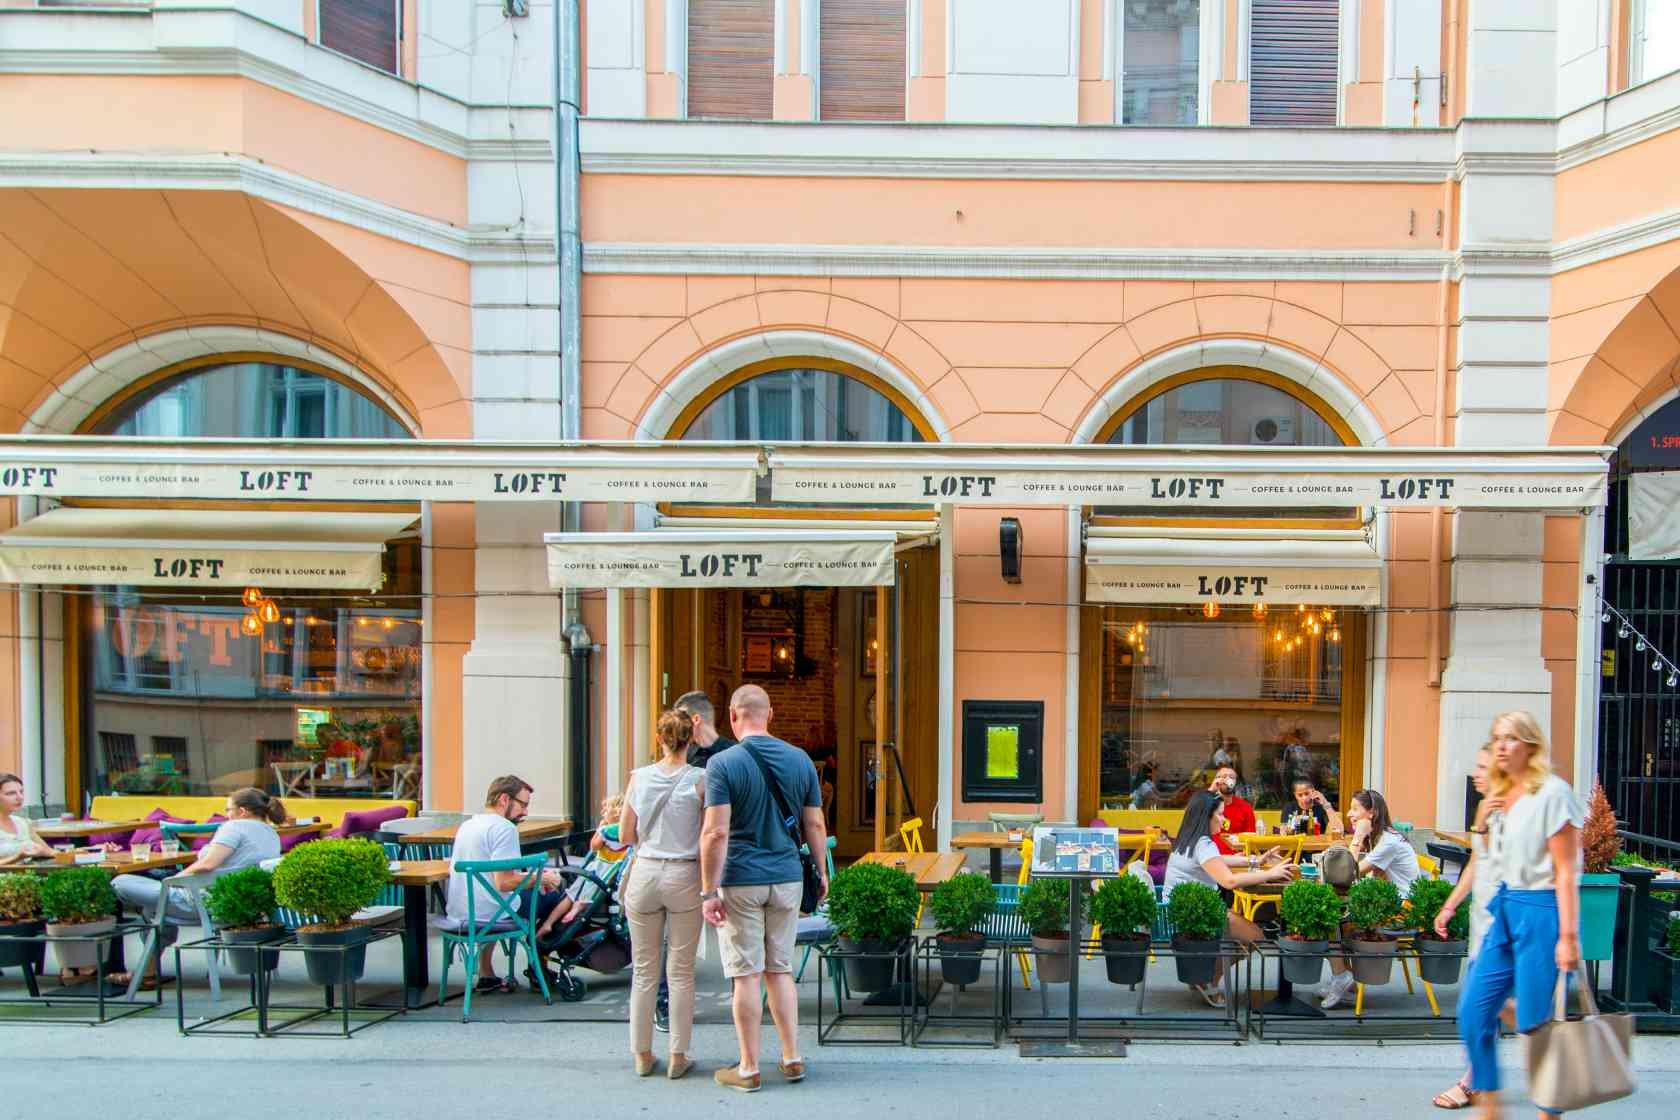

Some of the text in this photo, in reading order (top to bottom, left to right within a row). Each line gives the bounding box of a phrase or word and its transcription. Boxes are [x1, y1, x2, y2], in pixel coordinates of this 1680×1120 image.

[98, 475, 132, 483] COFFEE
[144, 475, 178, 483] LOUNGE
[181, 476, 200, 484] BAR
[240, 471, 312, 491] LOFT
[352, 478, 385, 486] COFFEE
[397, 479, 432, 487] LOUNGE
[436, 479, 454, 487] BAR
[494, 473, 566, 493] LOFT
[607, 481, 640, 489] COFFEE
[652, 481, 686, 489] LOUNGE
[690, 481, 708, 489] BAR
[795, 481, 828, 489] COFFEE
[840, 482, 875, 490] LOUNGE
[878, 482, 897, 490] BAR
[923, 476, 995, 496] LOFT
[1023, 484, 1056, 492] COFFEE
[1068, 485, 1102, 493] LOUNGE
[1106, 485, 1125, 493] BAR
[1151, 478, 1224, 498] LOFT
[1380, 479, 1454, 499] LOFT
[1251, 486, 1285, 494] COFFEE
[1297, 486, 1332, 494] LOUNGE
[1336, 486, 1354, 494] BAR
[1481, 486, 1515, 494] COFFEE
[1527, 486, 1562, 494] LOUNGE
[1566, 486, 1584, 494] BAR
[32, 564, 62, 572] COFFEE
[74, 564, 106, 572] LOUNGE
[110, 565, 128, 573] BAR
[154, 558, 223, 578] LOFT
[564, 562, 596, 570] COFFEE
[607, 562, 640, 570] LOUNGE
[642, 562, 660, 570] BAR
[680, 554, 762, 577] LOFT
[783, 562, 815, 570] COFFEE
[825, 561, 859, 569] LOUNGE
[861, 561, 878, 569] BAR
[249, 567, 281, 575] COFFEE
[292, 568, 327, 576] LOUNGE
[329, 568, 347, 576] BAR
[1102, 581, 1128, 589] COFFEE
[1136, 582, 1165, 590] LOUNGE
[1166, 582, 1181, 590] BAR
[1198, 576, 1268, 596] LOFT
[1285, 584, 1312, 592] COFFEE
[1320, 584, 1349, 592] LOUNGE
[1351, 584, 1366, 592] BAR
